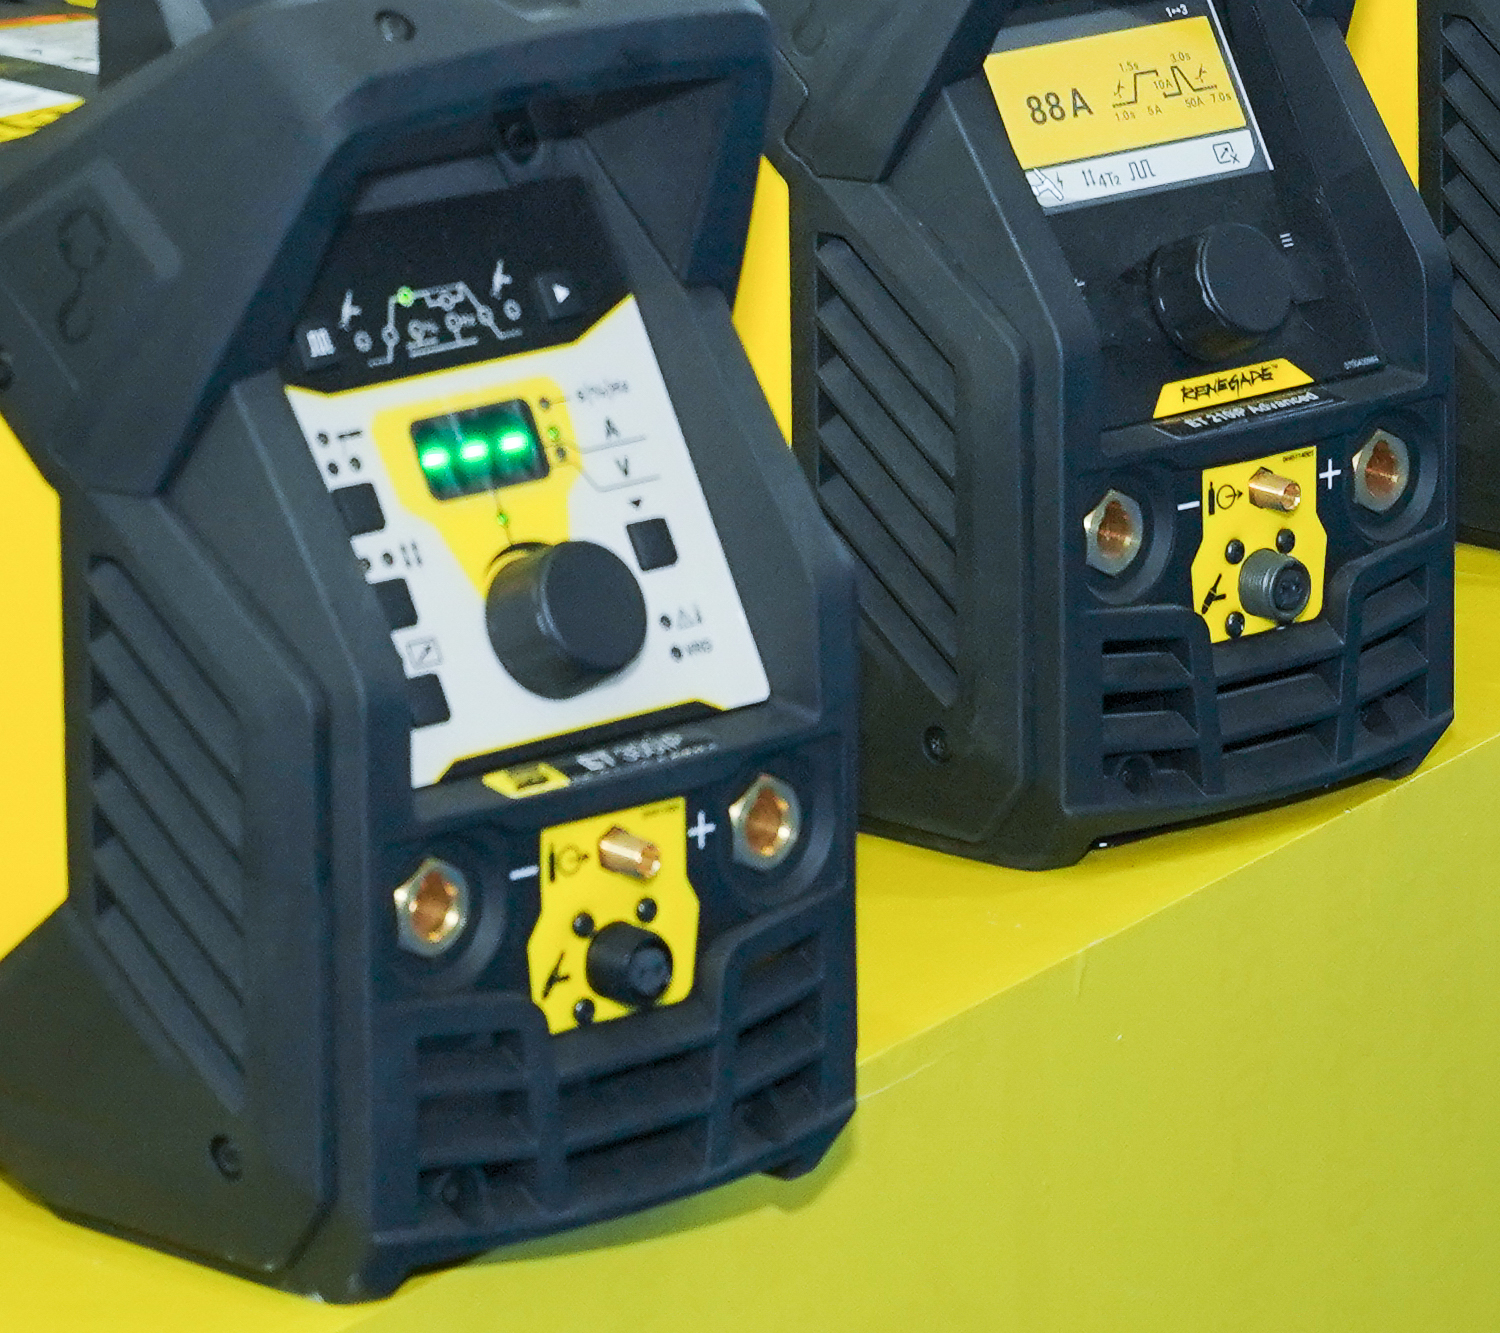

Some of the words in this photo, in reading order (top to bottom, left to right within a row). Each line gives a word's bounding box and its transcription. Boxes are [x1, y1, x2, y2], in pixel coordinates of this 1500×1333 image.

[1180, 365, 1274, 403] RENEGADE
[604, 417, 618, 438] A
[615, 457, 630, 478] V
